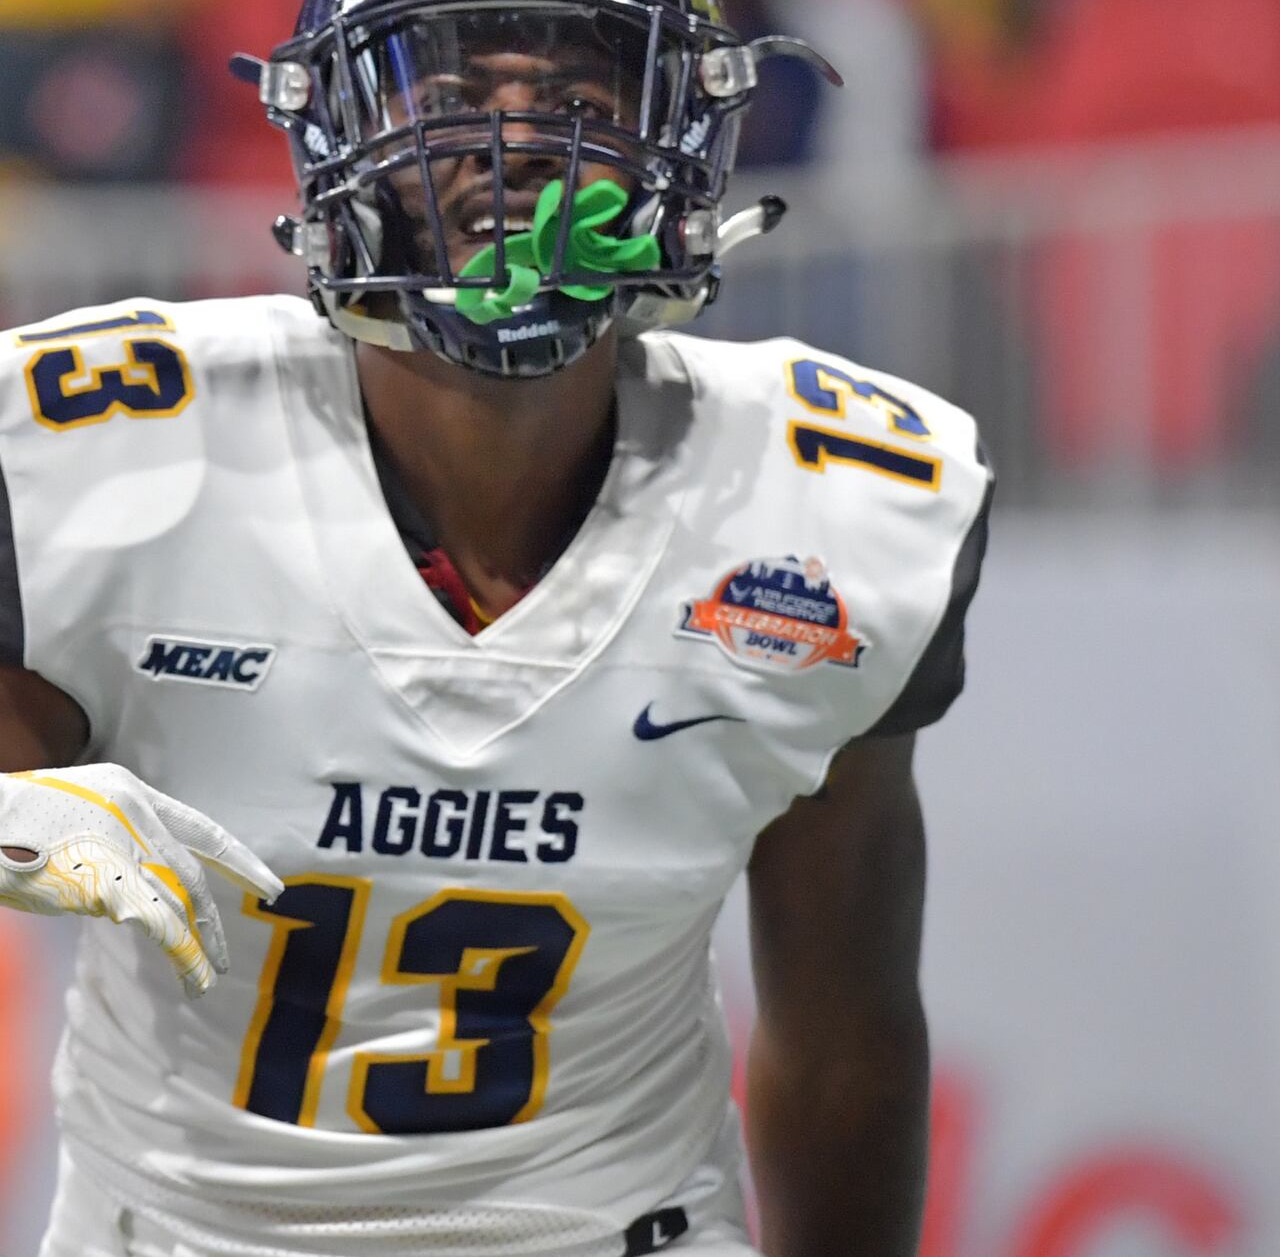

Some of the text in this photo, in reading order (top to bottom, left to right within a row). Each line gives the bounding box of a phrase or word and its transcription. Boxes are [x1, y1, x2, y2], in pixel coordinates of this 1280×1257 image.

[14, 310, 195, 433] 13
[784, 357, 943, 492] 13
[714, 604, 838, 647] CELEBRATION
[754, 598, 831, 623] RESERVE
[142, 637, 271, 687] MEAC
[746, 631, 798, 656] BOWL
[316, 782, 585, 863] AGGIES
[233, 871, 592, 1136] 13
